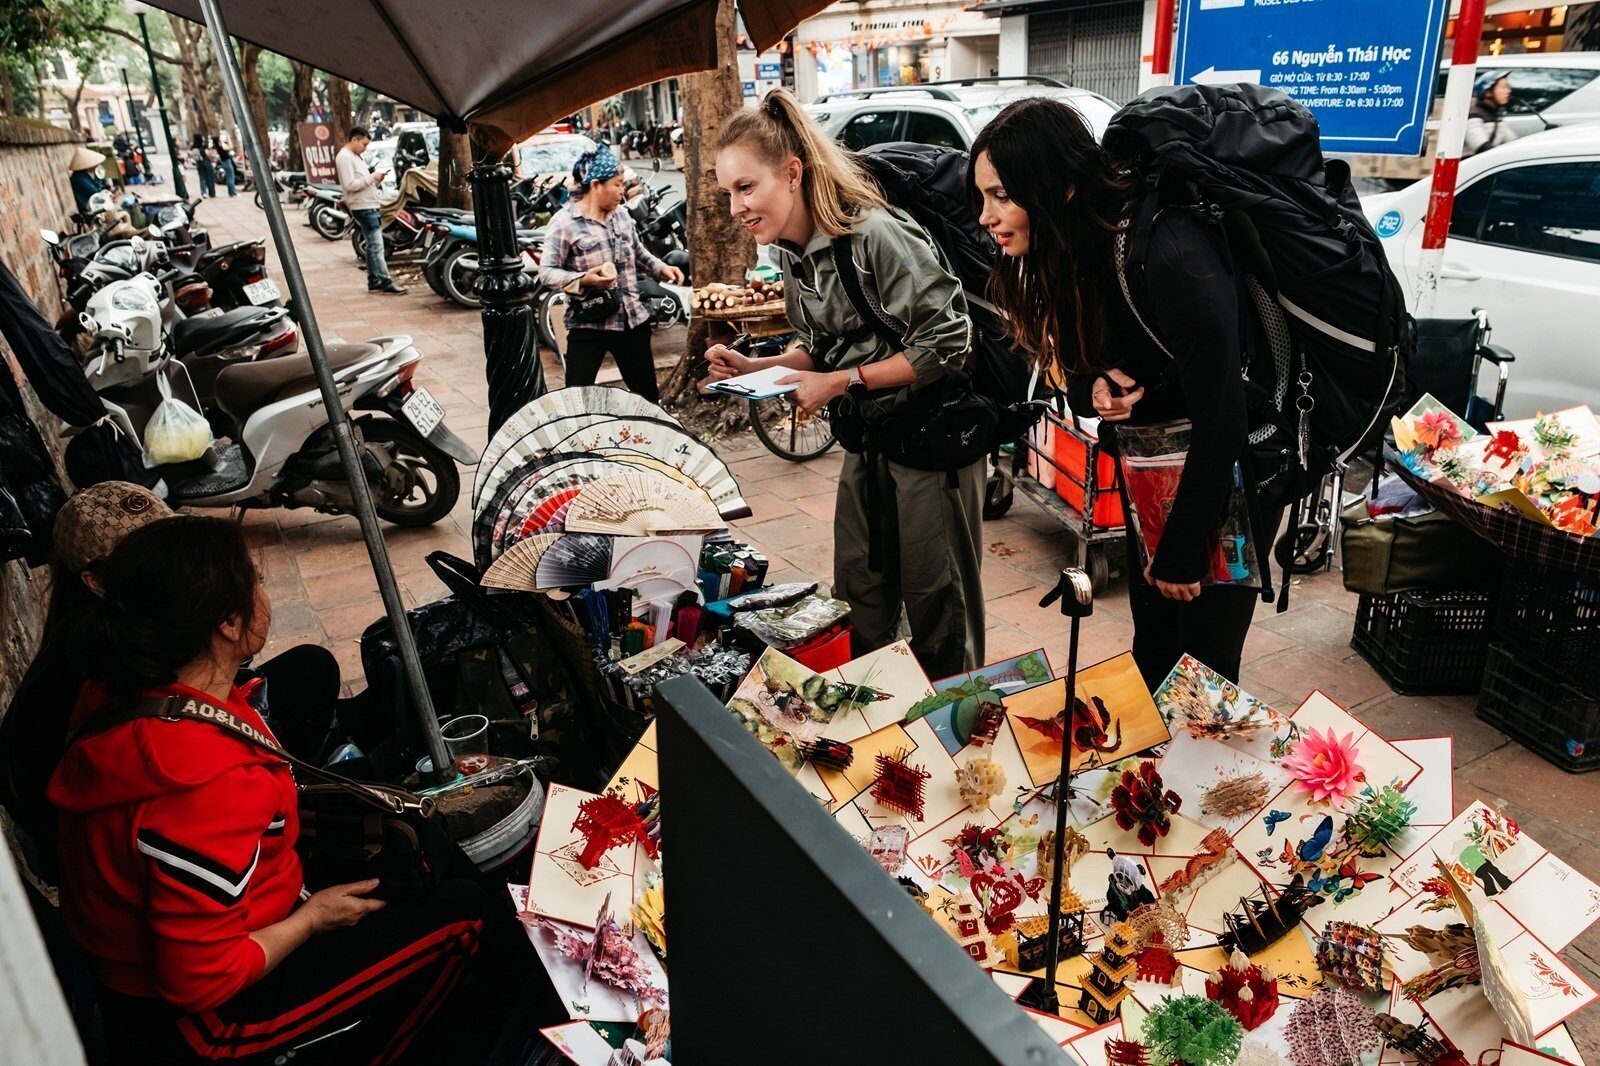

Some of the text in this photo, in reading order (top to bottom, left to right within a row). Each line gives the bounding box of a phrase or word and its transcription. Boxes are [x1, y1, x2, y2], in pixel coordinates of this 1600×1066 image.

[865, 22, 898, 30] FOOTBALL
[1272, 44, 1411, 67] 66 Nguyễn Thái Học
[1316, 73, 1326, 82] Từ
[1326, 72, 1342, 82] 8:30
[1349, 72, 1370, 81] 17:00
[1271, 86, 1298, 95] NING
[1300, 86, 1319, 95] TIME:
[1321, 86, 1338, 94] From
[1340, 86, 1366, 94] 8:30am
[1373, 85, 1402, 95] 5:00pm
[1345, 98, 1355, 107] De
[1357, 98, 1373, 107] 8:30
[1382, 98, 1404, 107] 17:00
[407, 391, 430, 418] 29-E2
